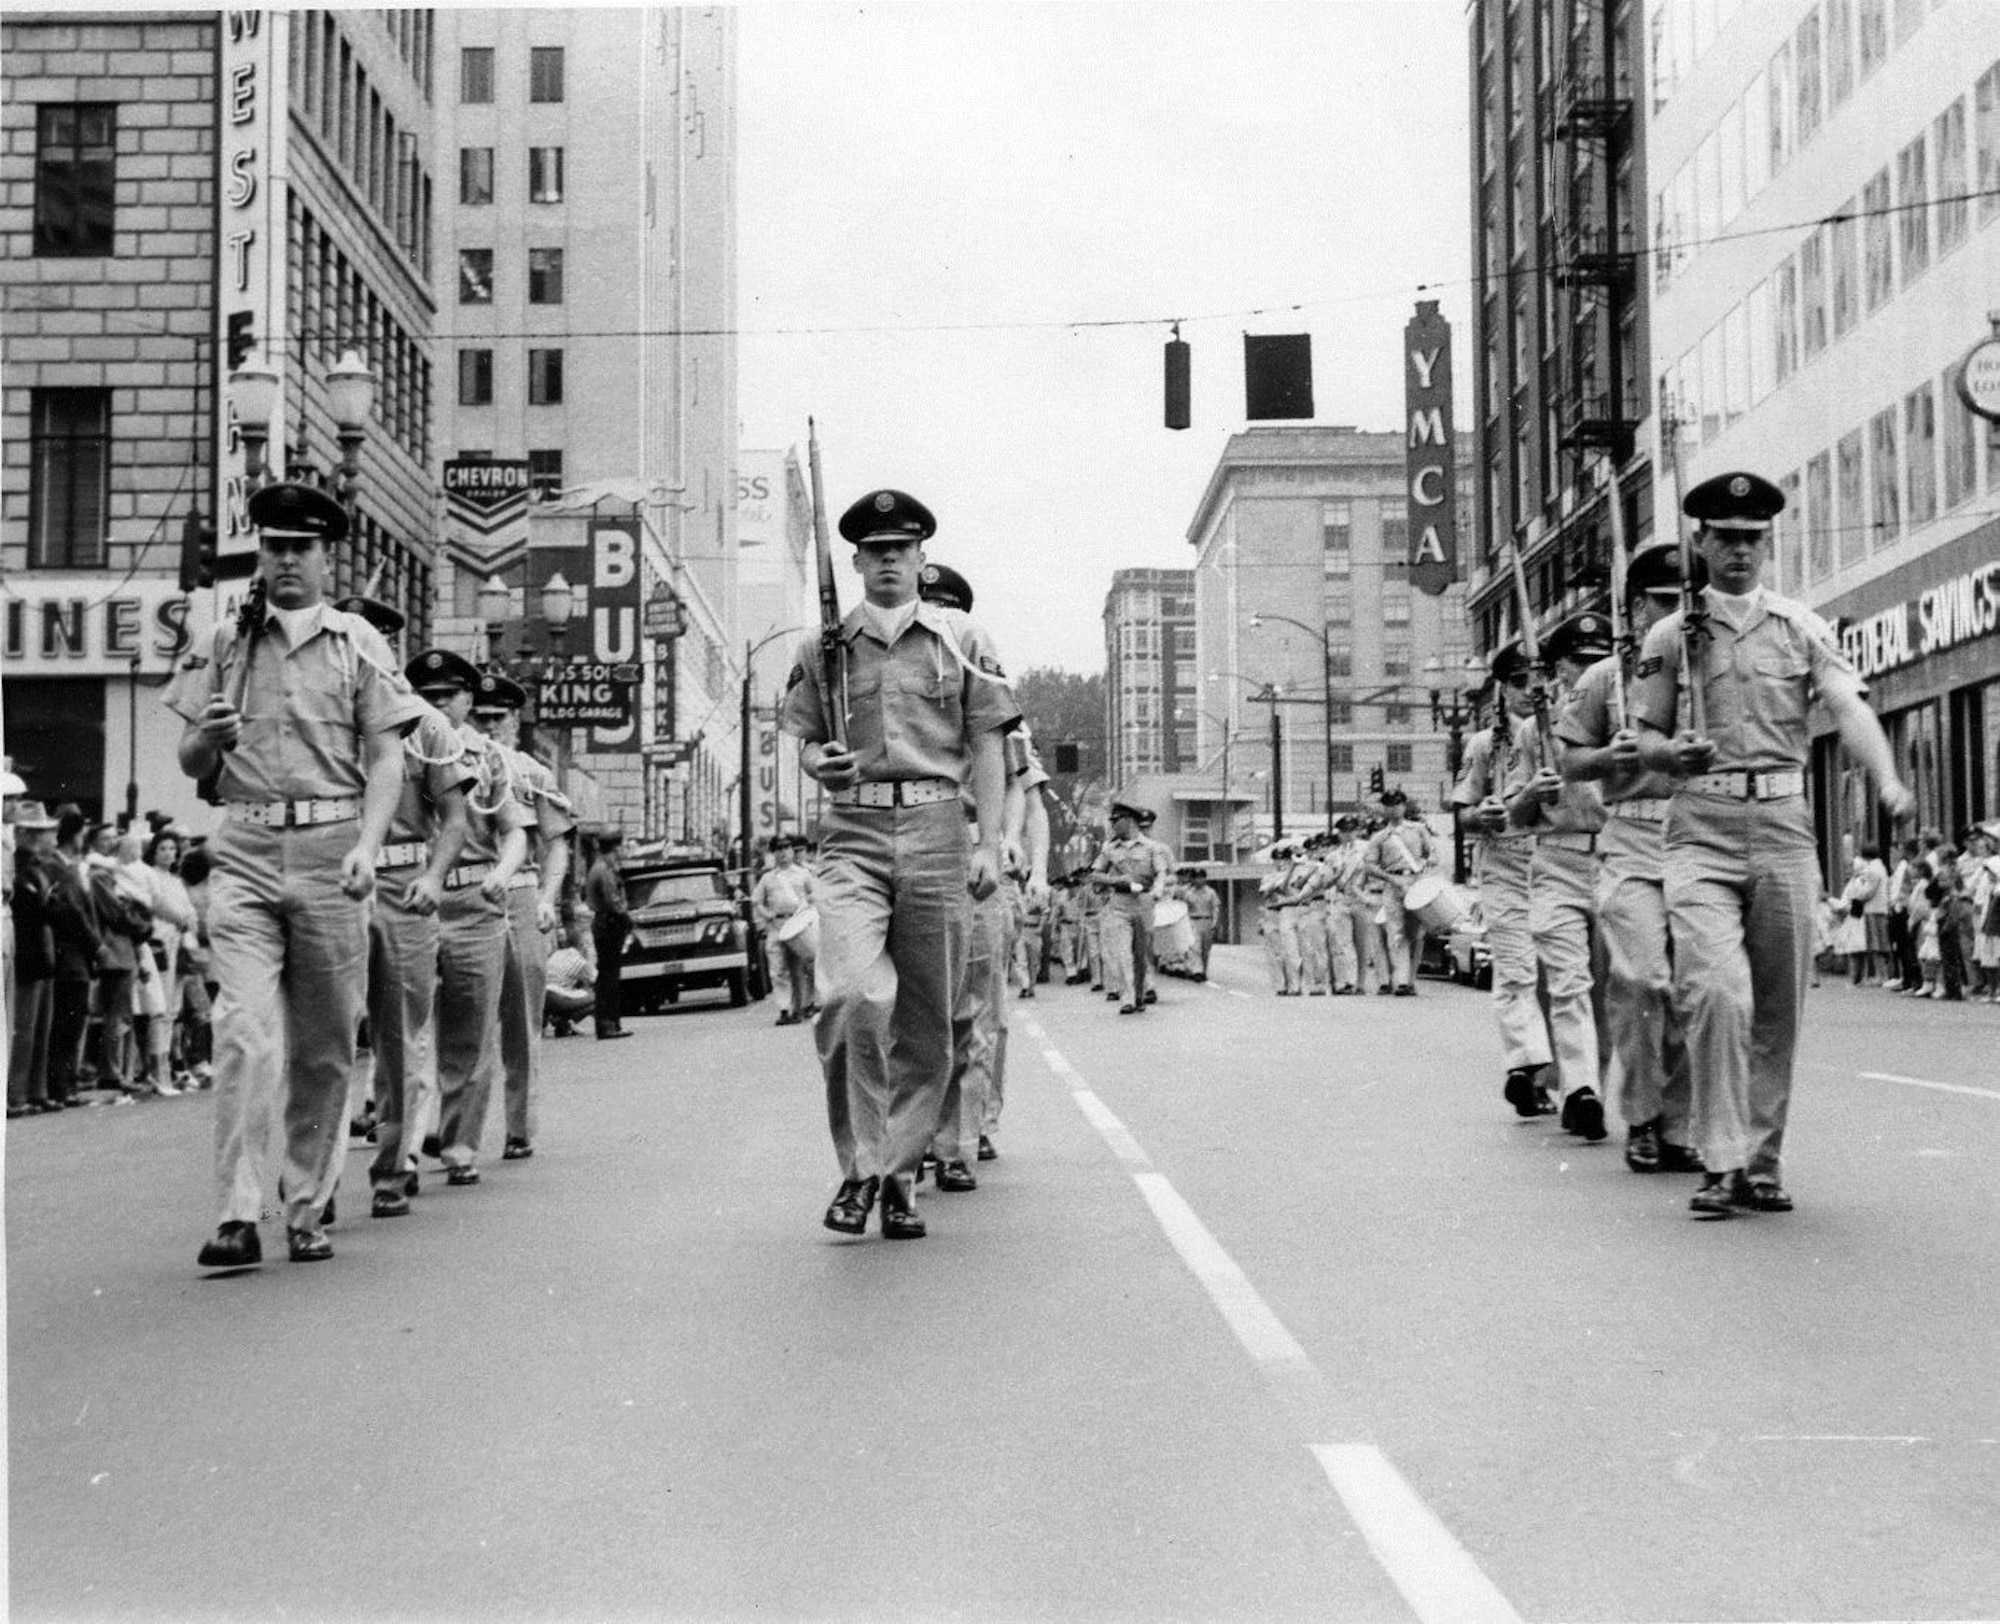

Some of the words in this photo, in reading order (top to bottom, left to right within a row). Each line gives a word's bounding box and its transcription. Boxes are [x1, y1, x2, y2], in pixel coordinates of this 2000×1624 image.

[446, 466, 528, 488] CHEVRON
[1409, 347, 1447, 564] YMCA
[1843, 602, 1914, 679] FEDERAL
[1919, 561, 2000, 655] SAVINGS
[539, 706, 576, 719] BLDG
[578, 706, 622, 719] GARAGE
[540, 683, 614, 703] KING
[655, 643, 669, 726] BANK
[760, 730, 775, 829] BUS
